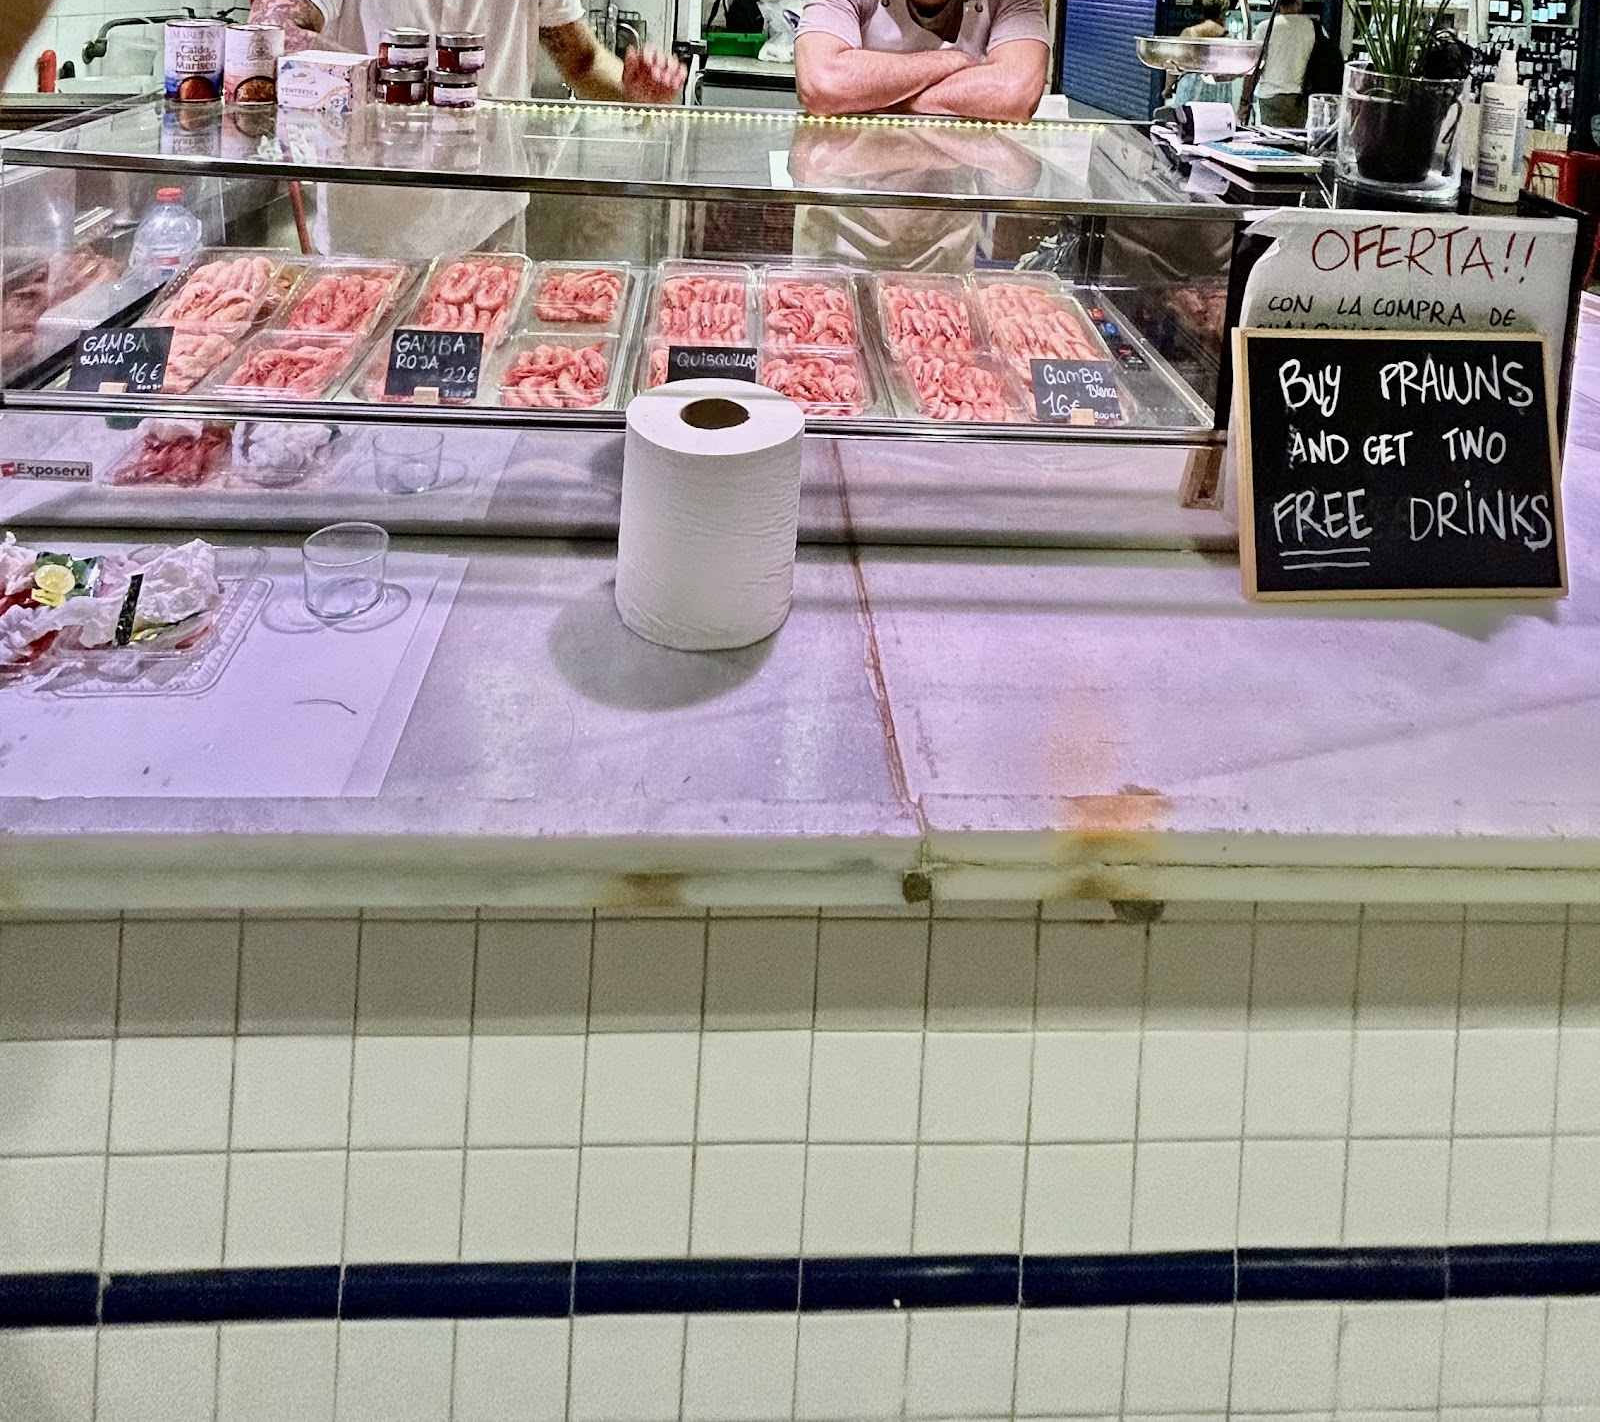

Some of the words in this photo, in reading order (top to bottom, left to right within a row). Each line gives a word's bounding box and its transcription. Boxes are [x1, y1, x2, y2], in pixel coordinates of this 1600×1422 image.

[175, 51, 217, 62] Pescado
[181, 45, 209, 54] Caldo
[175, 61, 217, 71] Marisco
[280, 86, 319, 96] VENTRESCA
[1311, 224, 1536, 283] OFERTA!!
[1268, 294, 1313, 314] CON
[1337, 296, 1361, 316] LA
[1373, 298, 1466, 327] COMPRA
[1489, 307, 1517, 327] DE
[83, 332, 149, 353] GAMBA
[396, 333, 466, 356] GAMBA
[80, 351, 124, 366] BLANCA
[395, 353, 440, 370] ROJA
[441, 366, 478, 384] 22€
[1379, 353, 1534, 408] PRAWNS
[1289, 429, 1349, 465] AND
[1363, 431, 1413, 466] GET
[1442, 426, 1506, 464] TWO
[17, 463, 90, 478] Exposervi
[1272, 489, 1373, 543] FREE
